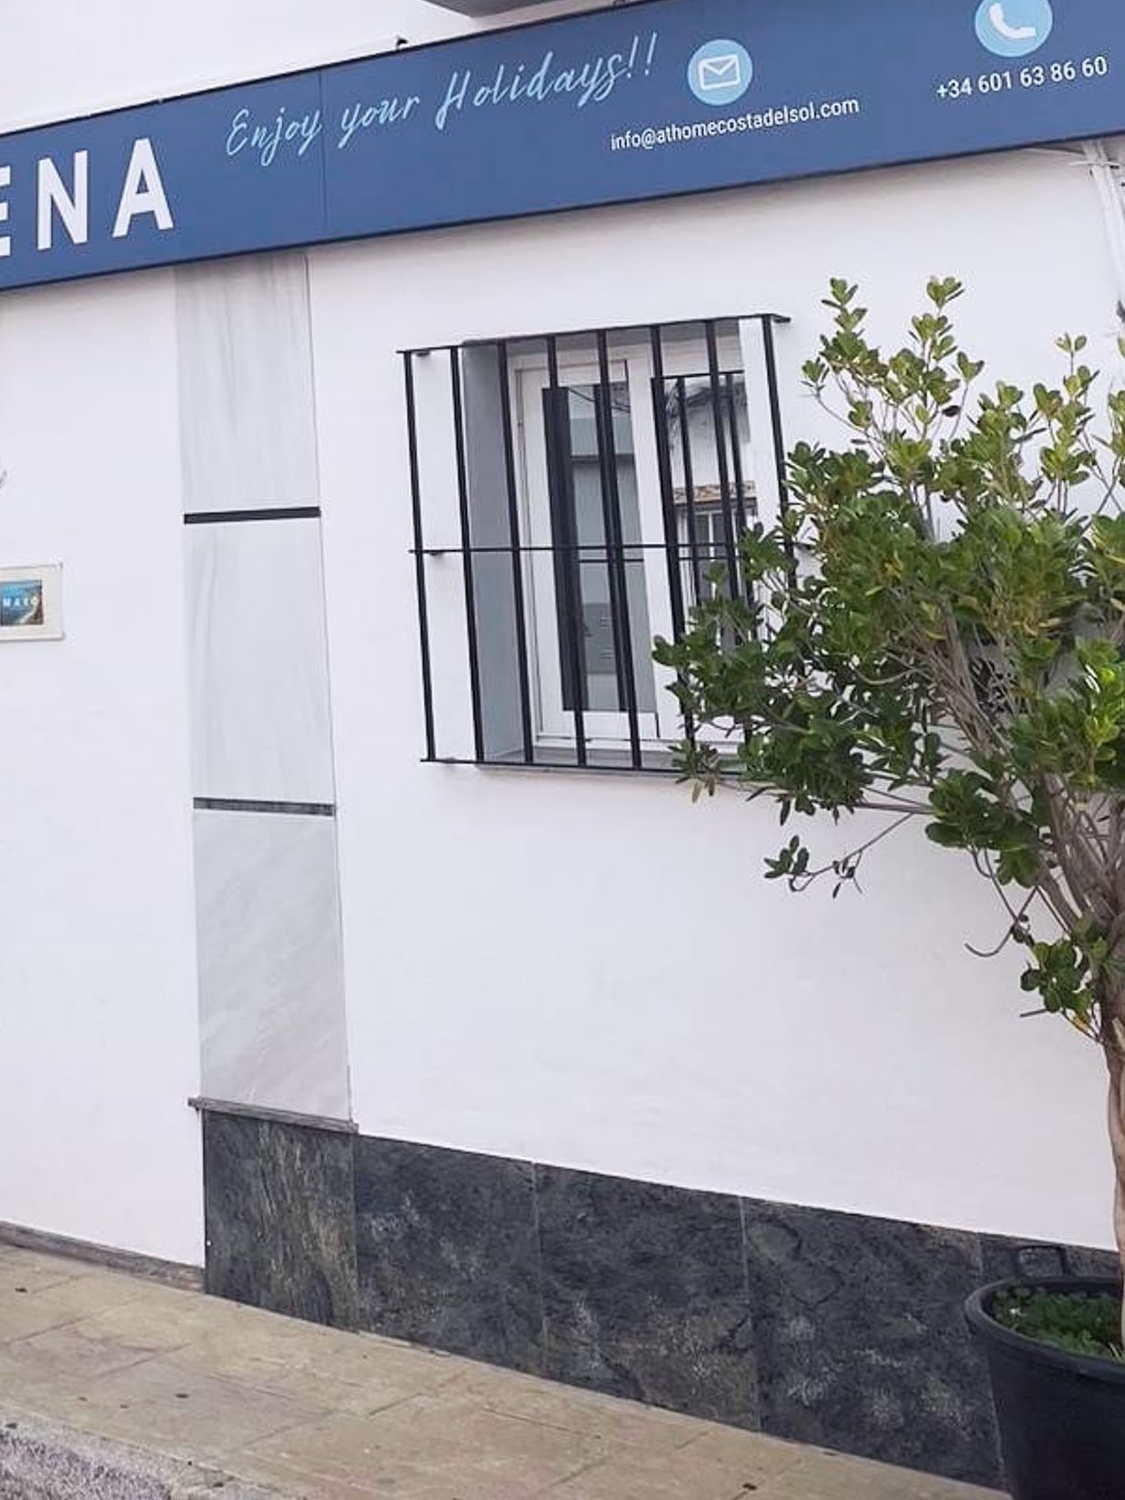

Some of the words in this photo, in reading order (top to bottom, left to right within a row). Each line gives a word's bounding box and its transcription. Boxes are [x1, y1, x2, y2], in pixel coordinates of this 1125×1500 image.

[226, 106, 323, 165] Enjoy
[338, 95, 420, 148] your
[434, 31, 658, 132] Holidays!!
[936, 77, 973, 99] +34
[978, 71, 1012, 93] 601
[1020, 66, 1044, 88] 63
[1050, 61, 1076, 82] 86
[1082, 56, 1107, 77] 60
[610, 99, 860, 151] info@athomecostadelsol.com
